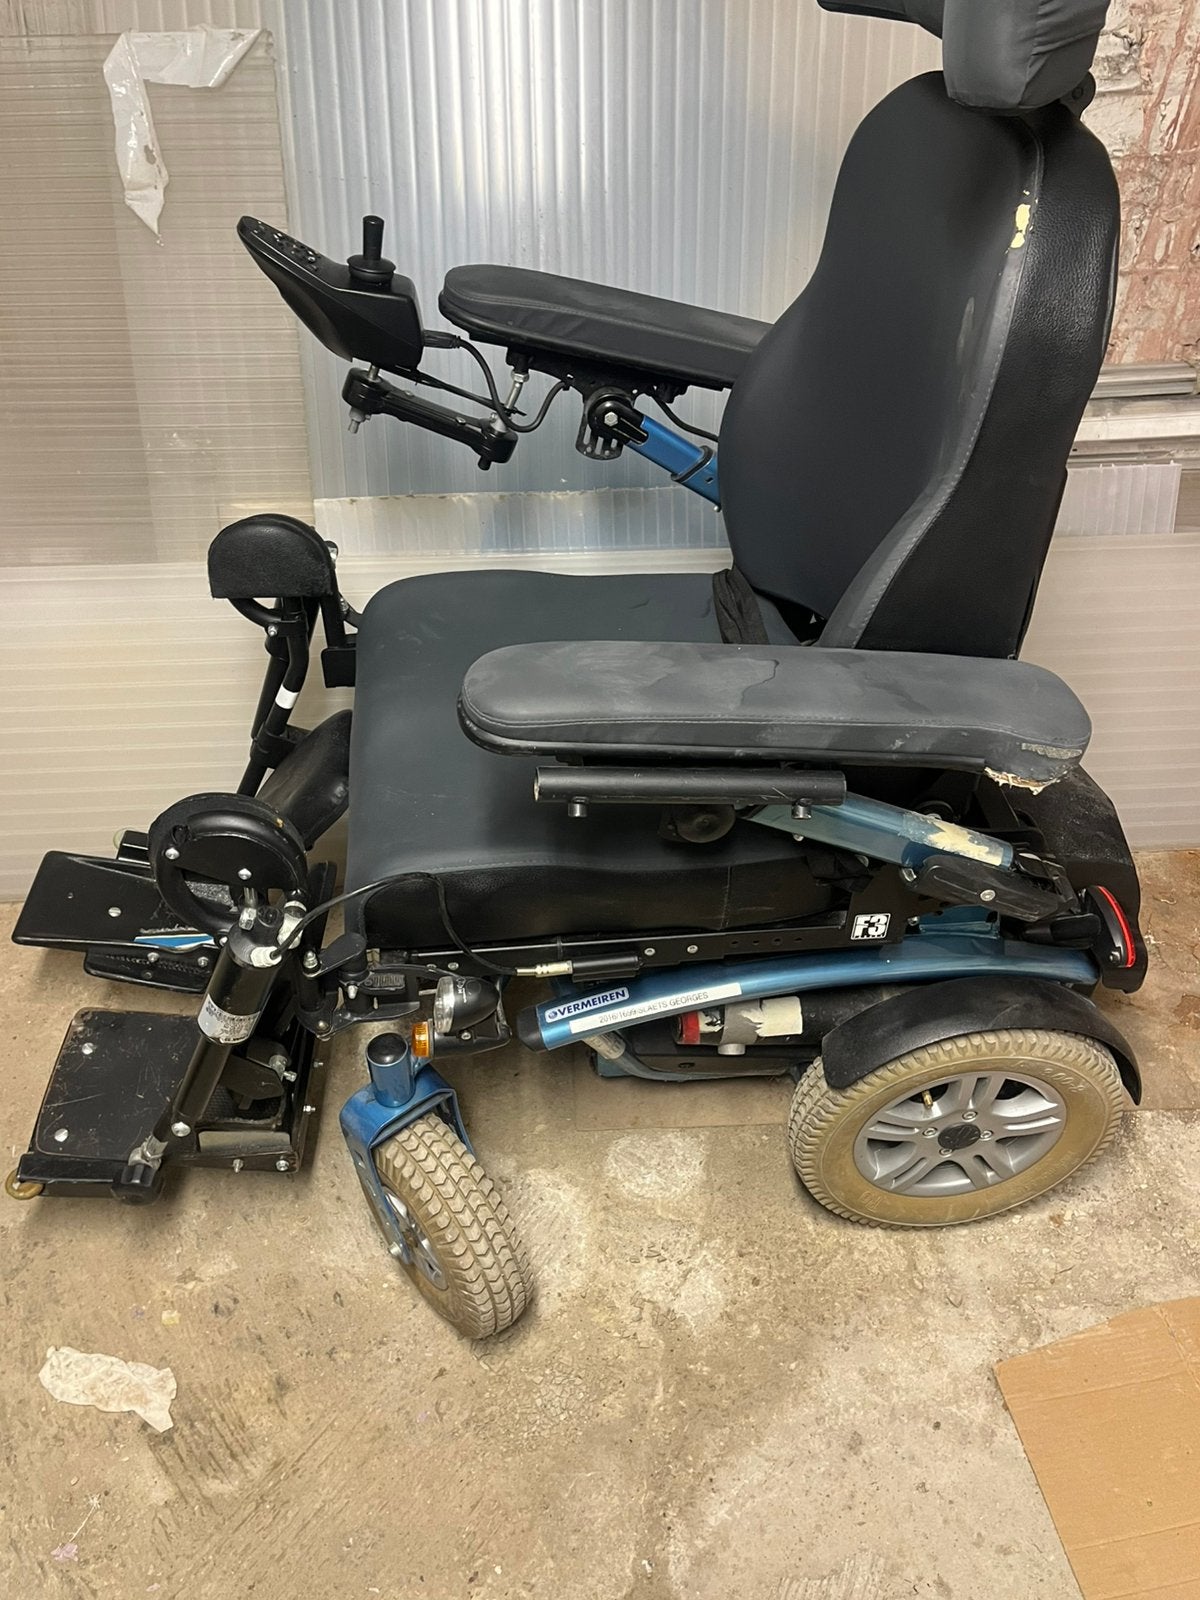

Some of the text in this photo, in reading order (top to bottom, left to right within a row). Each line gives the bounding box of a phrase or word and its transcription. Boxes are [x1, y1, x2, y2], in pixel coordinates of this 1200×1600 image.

[853, 914, 888, 938] F3
[557, 989, 626, 1016] VERMEIREN
[669, 991, 709, 1007] GEORGES
